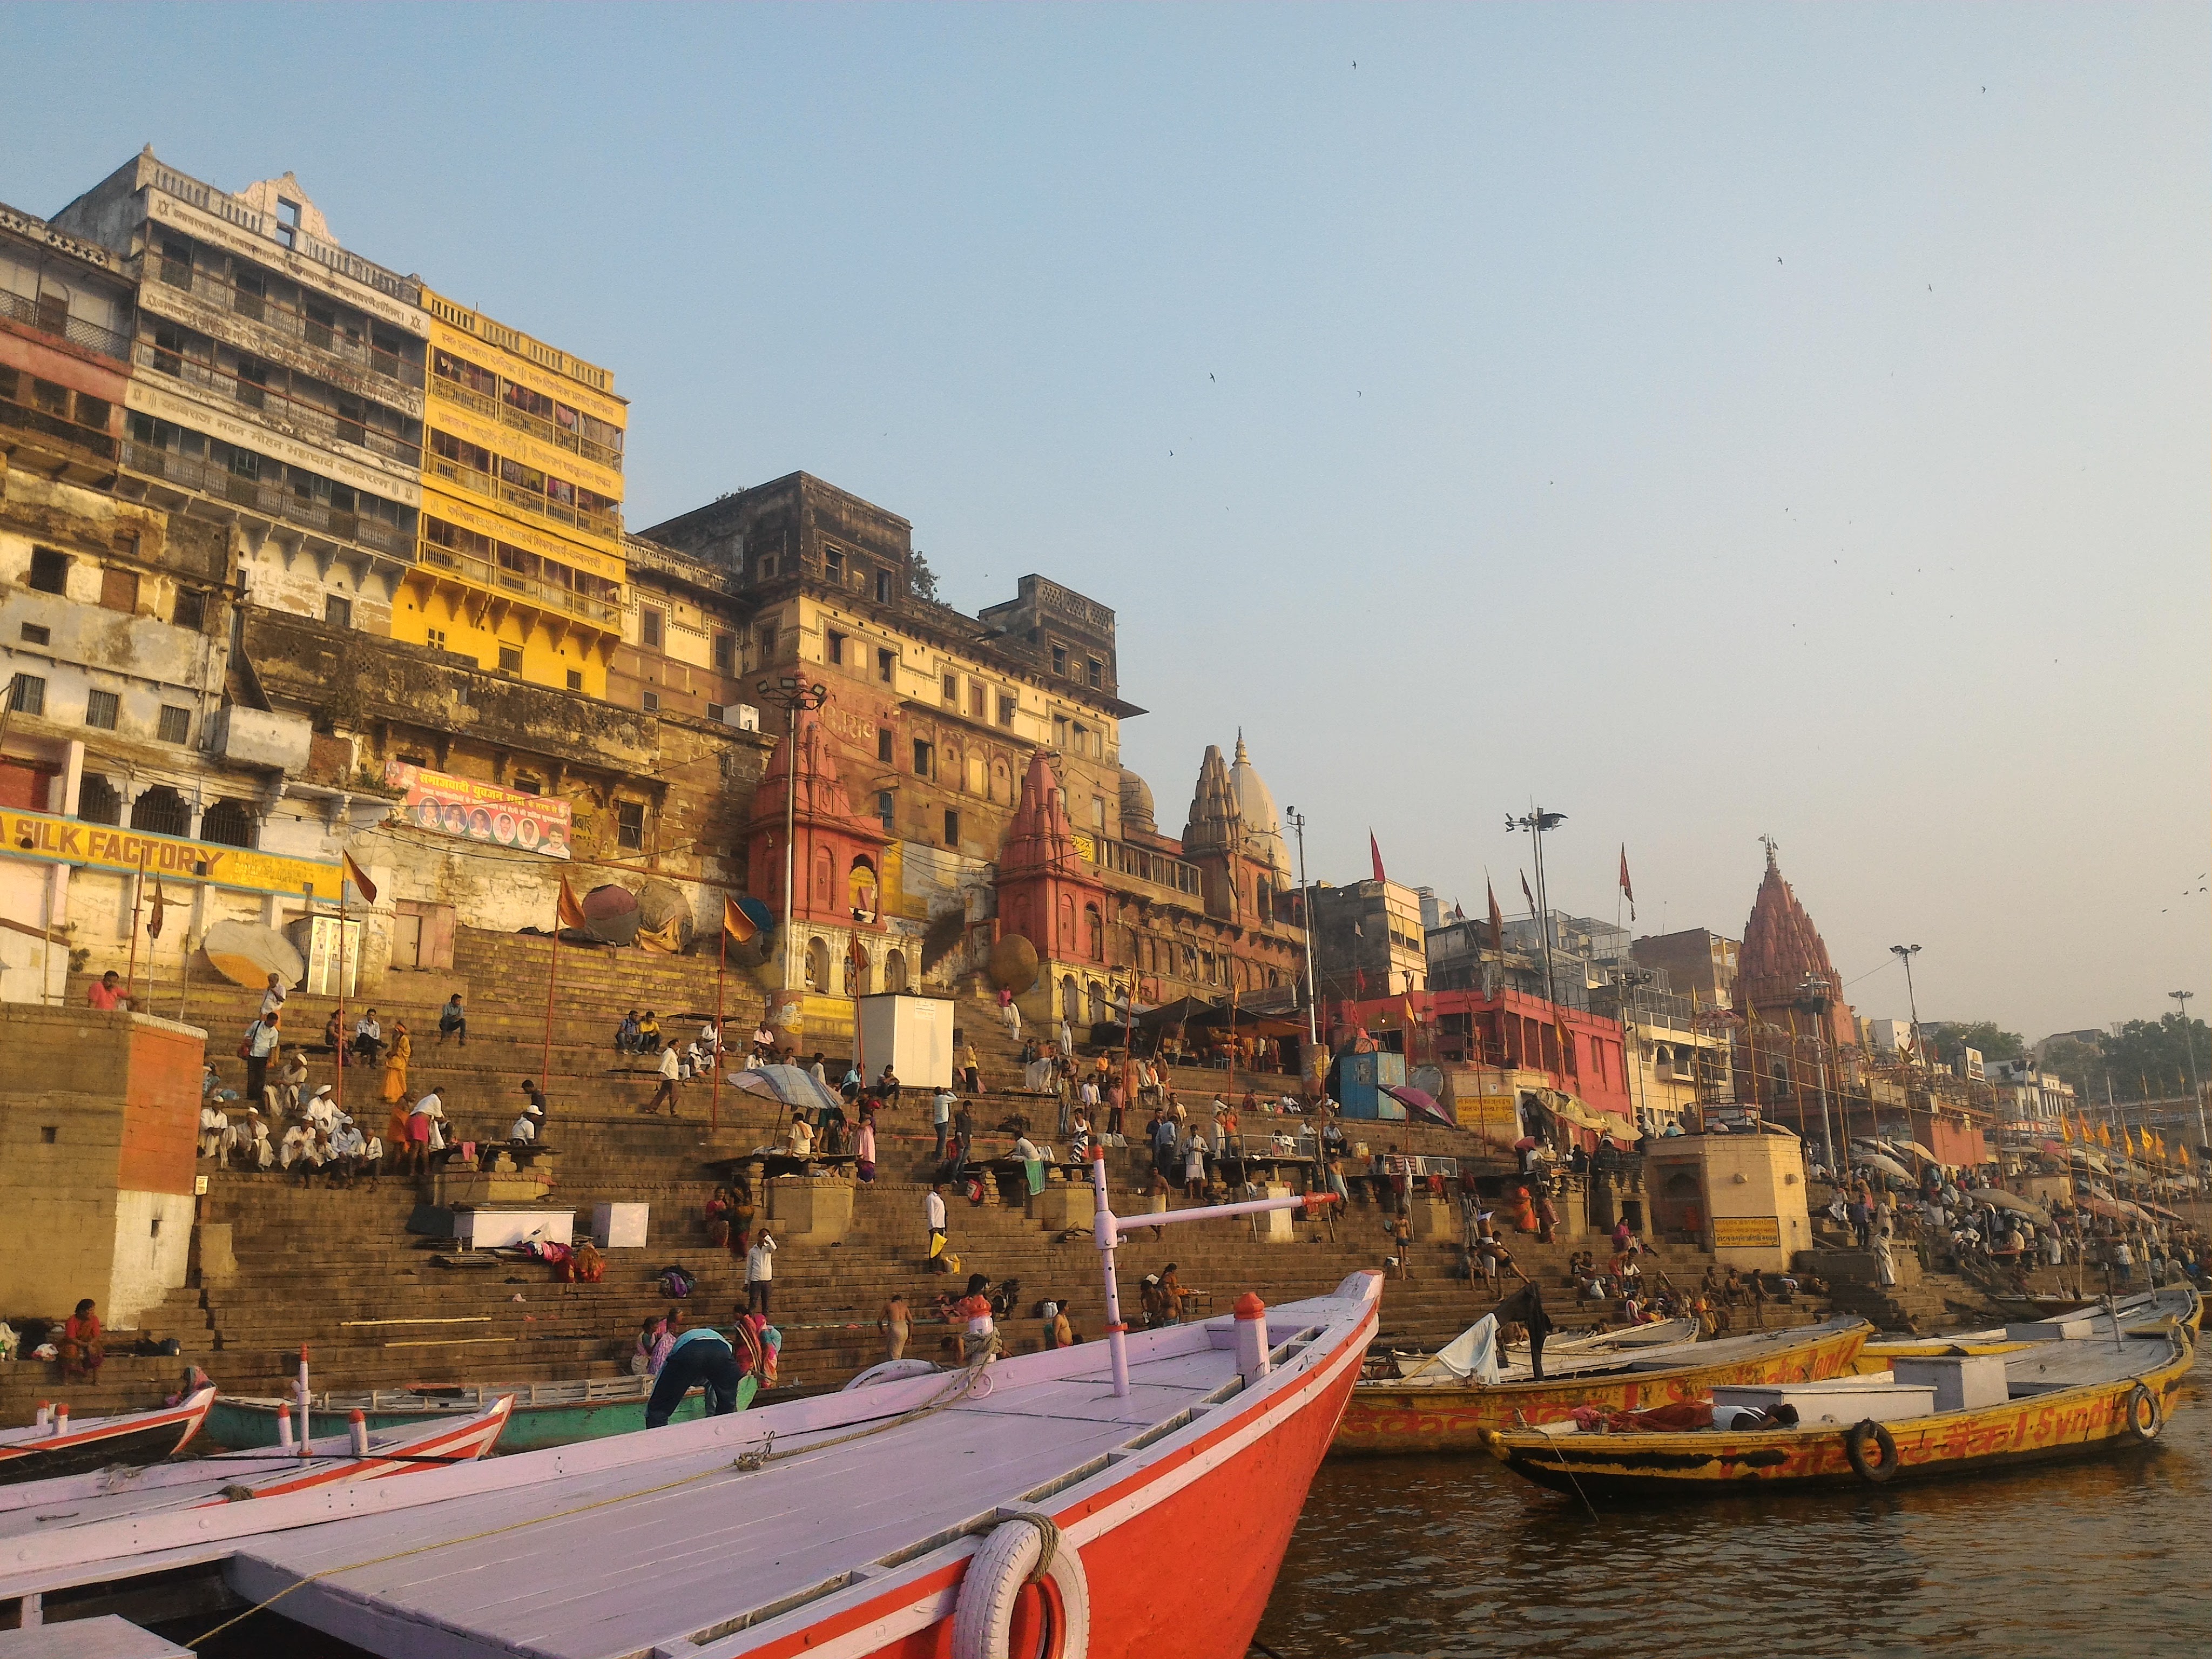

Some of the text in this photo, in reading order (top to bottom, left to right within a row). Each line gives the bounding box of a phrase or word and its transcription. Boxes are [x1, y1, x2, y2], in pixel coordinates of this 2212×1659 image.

[162, 400, 211, 424] कविराज
[251, 430, 285, 450] मोहन
[419, 773, 470, 793] समाजवादी
[472, 785, 504, 801] युवजन
[14, 819, 82, 856] SILK
[87, 831, 225, 876] FACTORY
